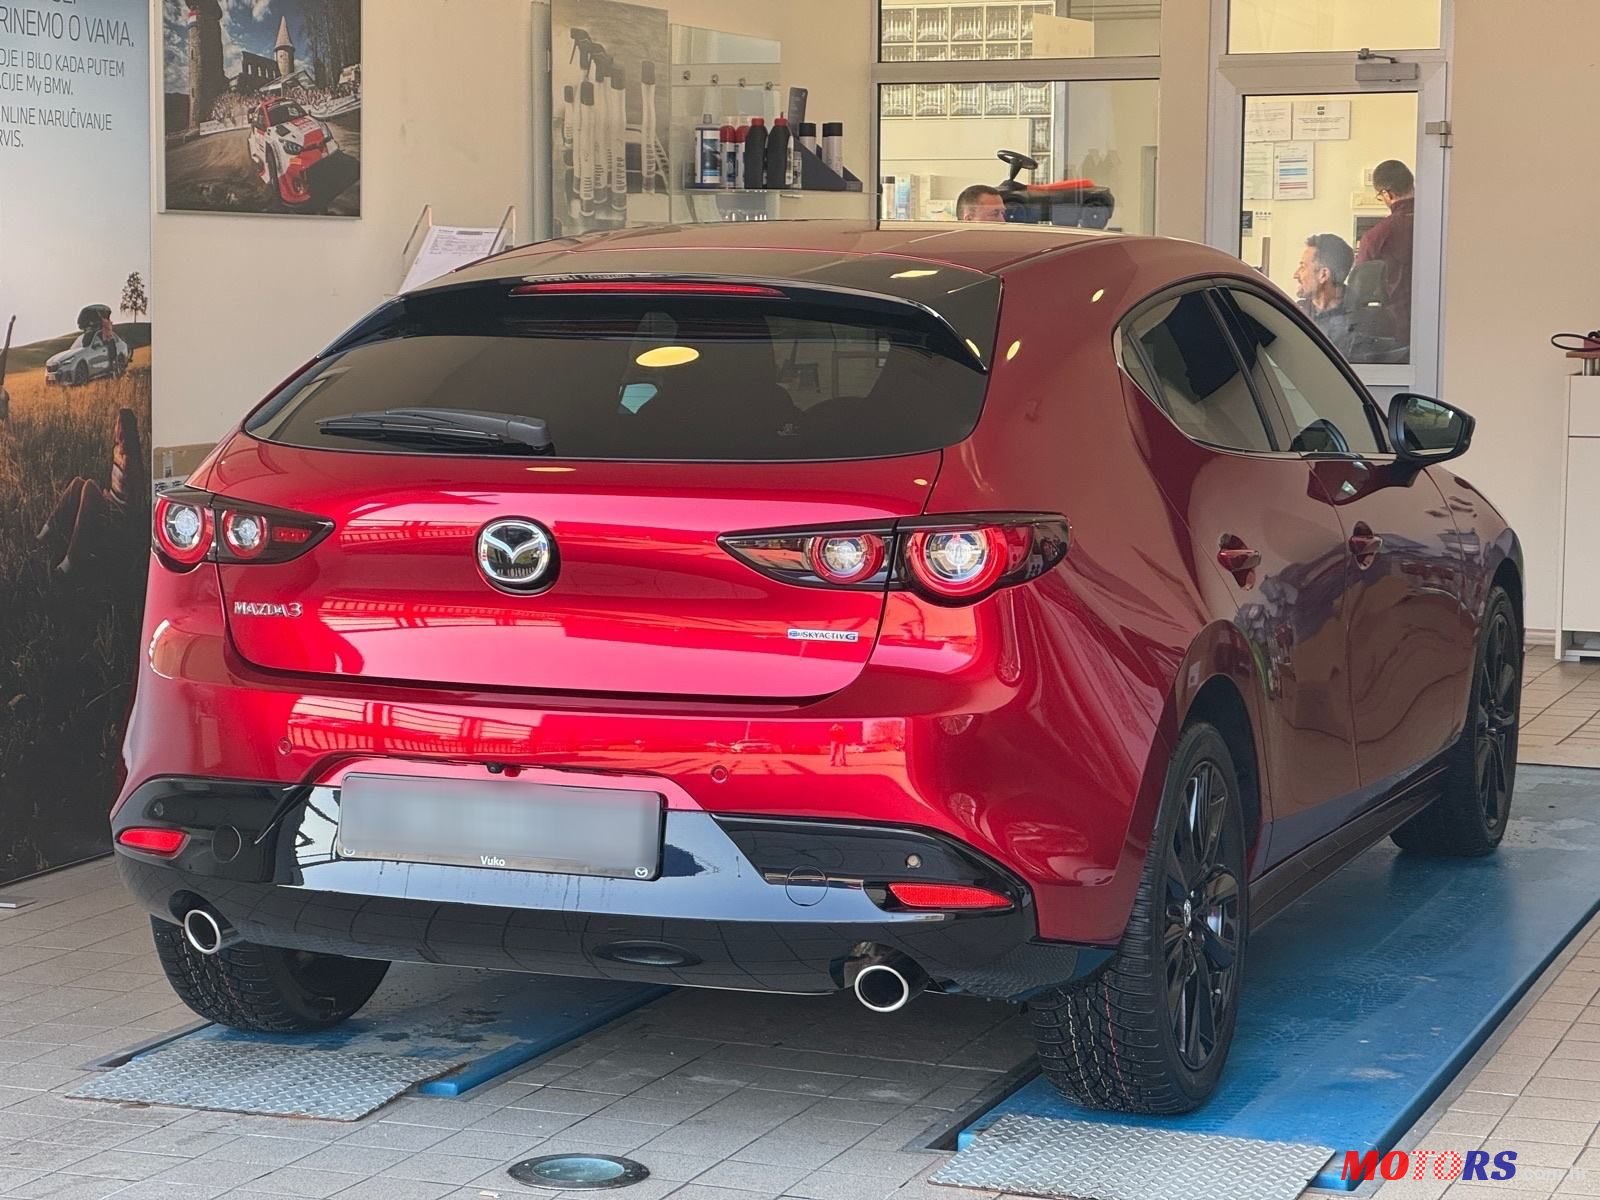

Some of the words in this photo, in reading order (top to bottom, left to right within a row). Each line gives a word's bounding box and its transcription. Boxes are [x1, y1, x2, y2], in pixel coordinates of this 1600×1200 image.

[68, 14, 81, 41] O
[84, 16, 135, 47] VAMA.
[21, 50, 24, 67] I
[26, 51, 52, 71] BILO
[55, 54, 85, 73] KADA
[87, 57, 125, 77] PUTEM
[0, 72, 23, 92] CIJE
[26, 75, 42, 96] My
[44, 76, 74, 95] BMW.
[38, 107, 113, 131] NARUČIVANJE
[480, 855, 506, 867] Vuko
